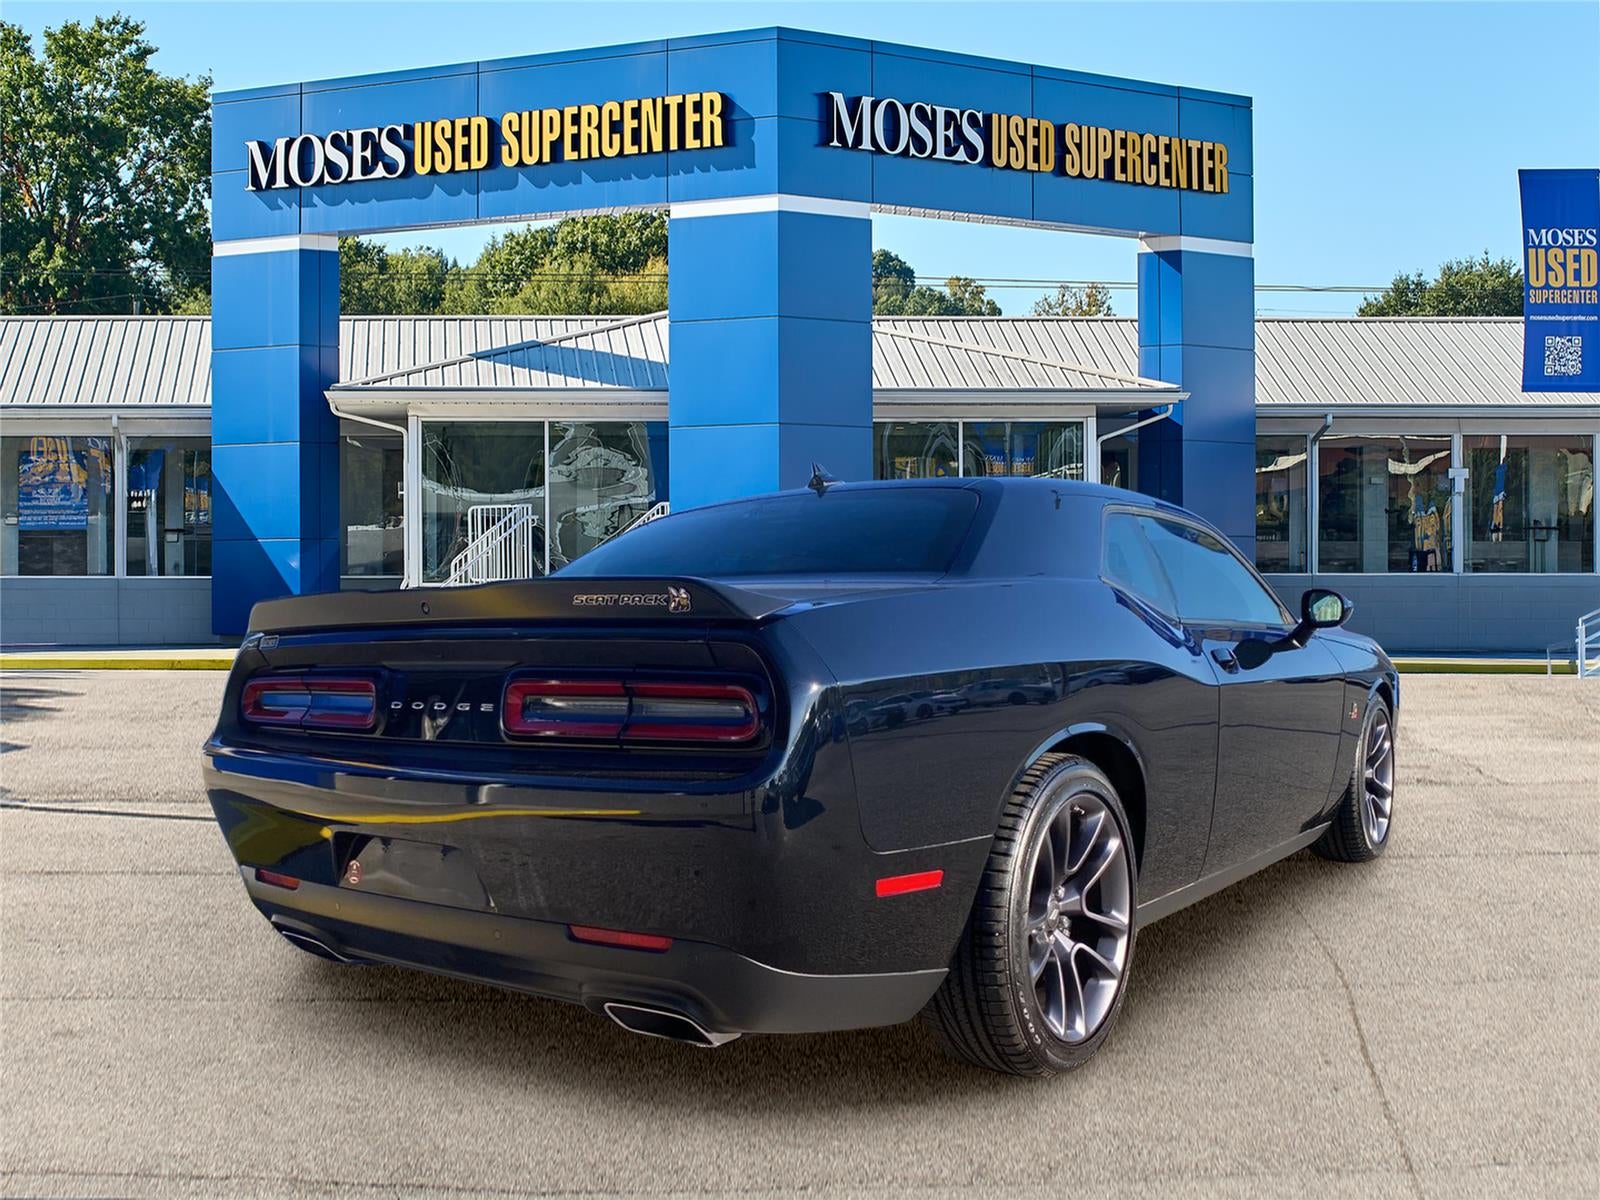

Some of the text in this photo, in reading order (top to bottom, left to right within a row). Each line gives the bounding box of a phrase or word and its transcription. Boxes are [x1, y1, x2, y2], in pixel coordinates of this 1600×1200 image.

[244, 91, 724, 191] MOSES USED SUPERCENTER
[828, 91, 1230, 194] MOSES USED SUPERCENTER
[1527, 228, 1597, 246] MOSES
[1528, 248, 1598, 288] USED
[1529, 289, 1598, 304] SUPERCENTER
[1529, 314, 1598, 322] mosesusedsupercenter.com
[572, 594, 669, 606] SCAT PACK
[391, 701, 494, 712] DODGE
